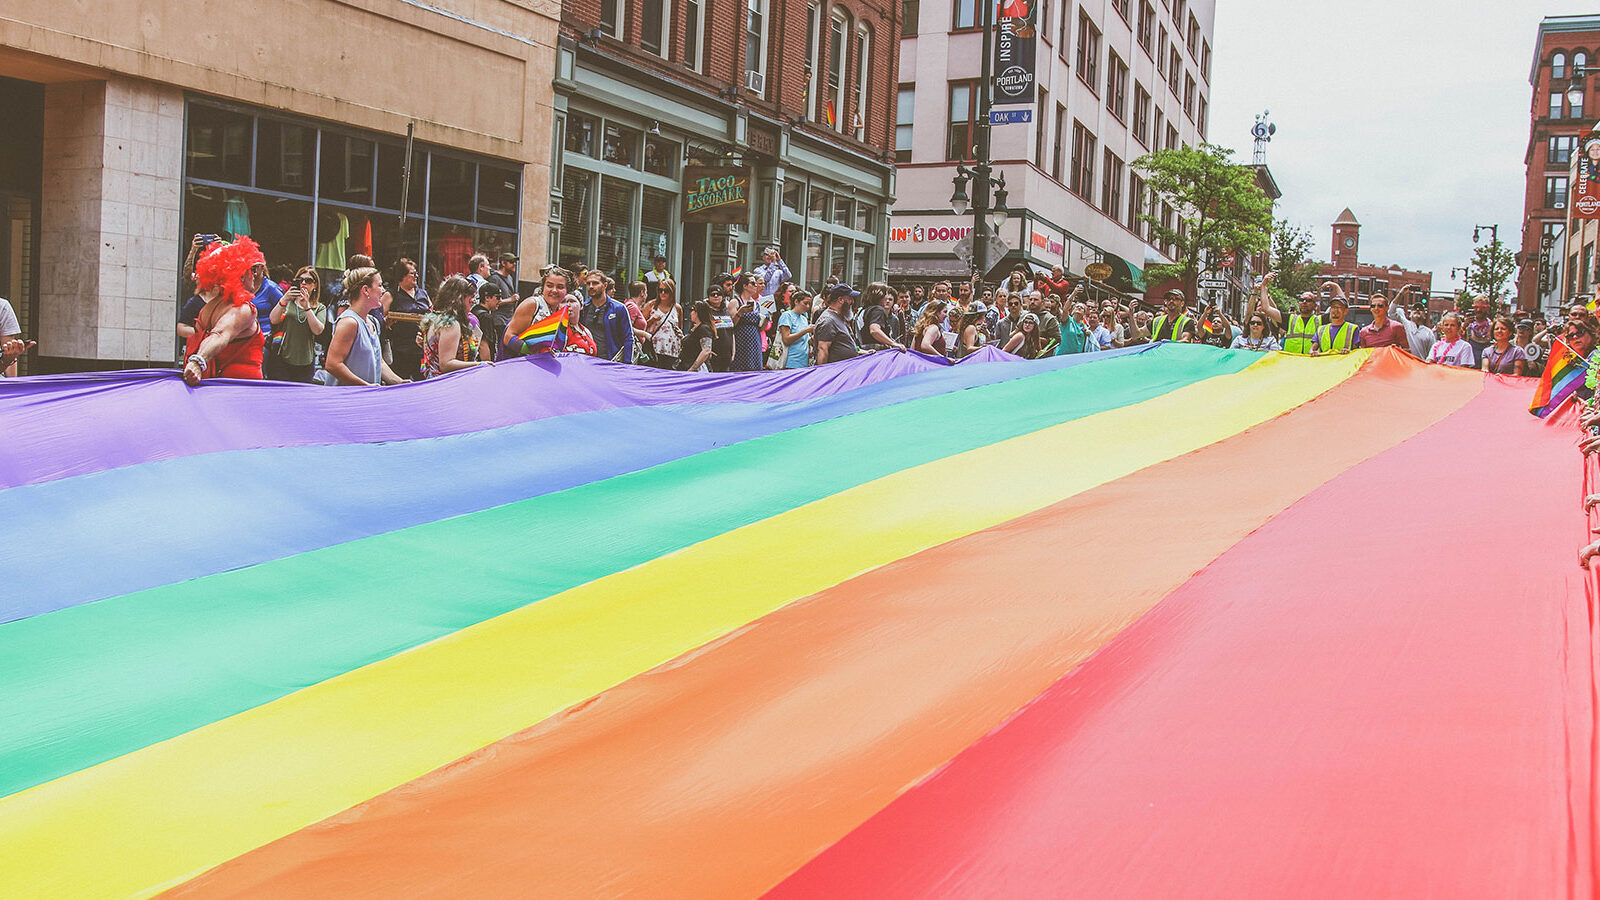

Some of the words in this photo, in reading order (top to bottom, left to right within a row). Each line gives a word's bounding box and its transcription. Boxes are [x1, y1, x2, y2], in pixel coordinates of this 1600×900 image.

[1000, 16, 1013, 62] INSPIRE
[996, 73, 1033, 86] PORTLAND
[994, 112, 1009, 122] OAK
[1255, 123, 1266, 137] 6
[695, 175, 736, 195] TACO
[1578, 157, 1589, 194] CELEBRATE
[687, 185, 745, 212] ESCOBARR
[1540, 238, 1550, 290] EMPIRE
